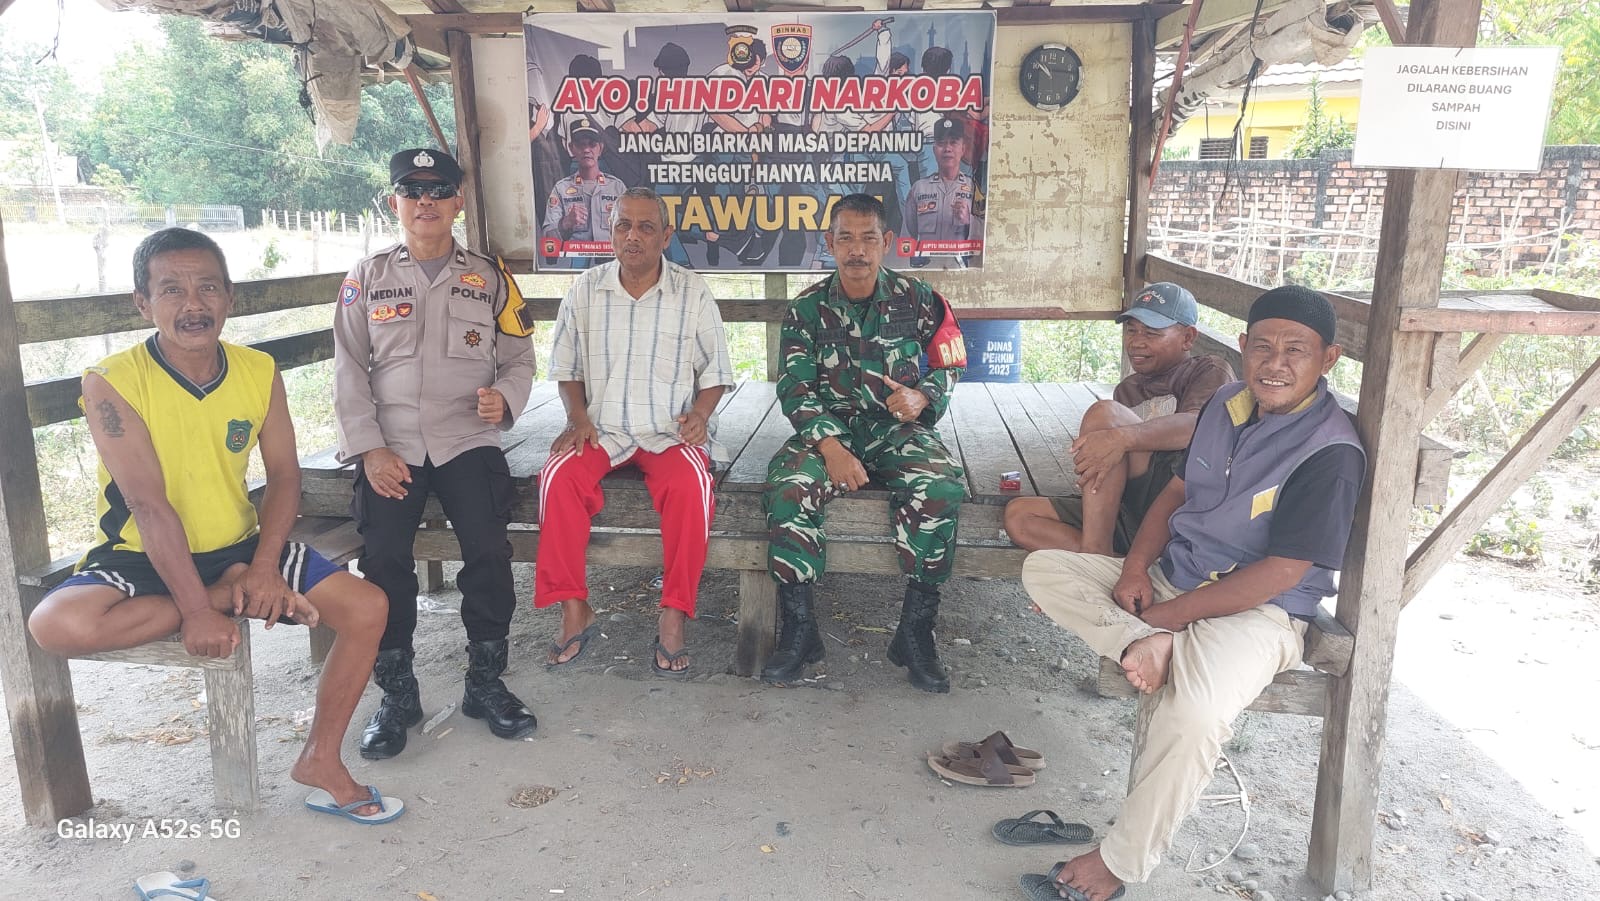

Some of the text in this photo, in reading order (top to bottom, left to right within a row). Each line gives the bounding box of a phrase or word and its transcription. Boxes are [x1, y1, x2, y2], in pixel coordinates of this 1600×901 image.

[1396, 64, 1529, 77] JAGALAH KEBERSIHAN
[554, 77, 630, 112] AYO
[655, 76, 806, 112] HINDARI
[810, 75, 983, 111] NARKOBA
[1407, 83, 1512, 95] DILARANG BUANG
[1431, 102, 1481, 113] SAMPAH
[1435, 120, 1472, 131] DISINI
[618, 132, 922, 153] JANGAN BIARKAN MASA DEPANMU
[647, 162, 893, 183] TERENGGUT HANYA KARENA
[661, 195, 883, 231] TAWUR
[370, 286, 414, 302] MEDIAN
[451, 286, 492, 304] POLRI
[987, 340, 1013, 352] DINAS
[988, 364, 1010, 376] 2023
